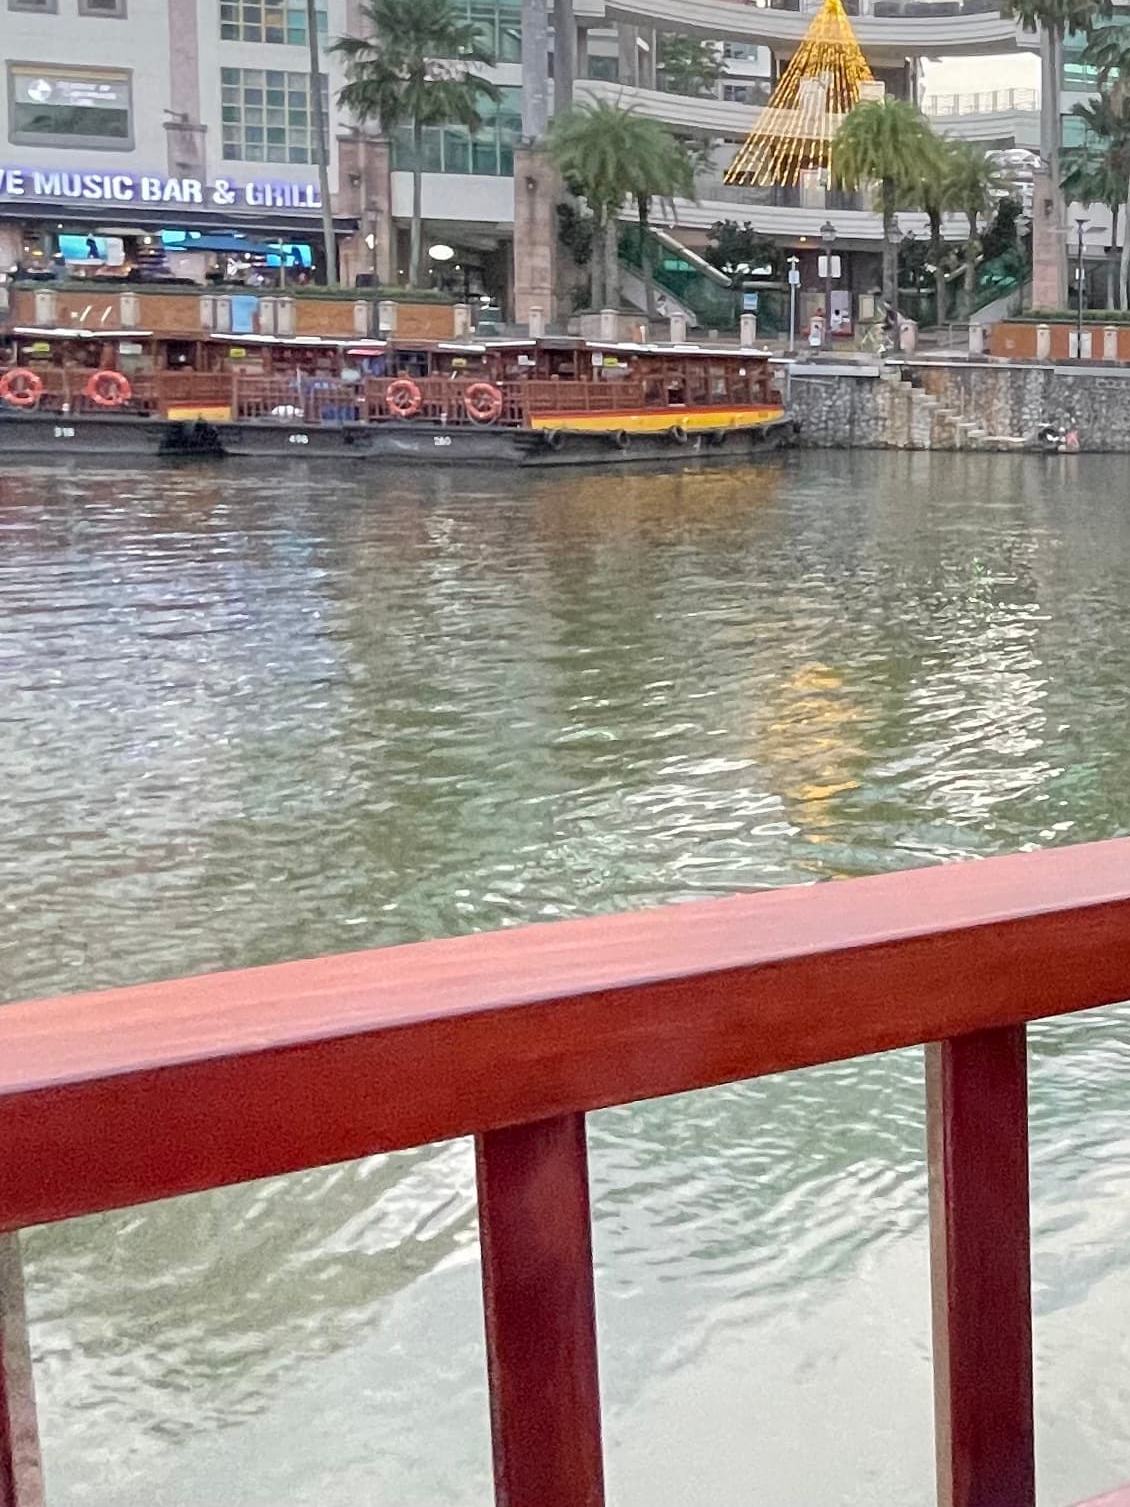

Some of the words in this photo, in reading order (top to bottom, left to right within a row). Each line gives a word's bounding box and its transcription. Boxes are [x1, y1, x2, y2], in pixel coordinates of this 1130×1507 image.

[32, 171, 134, 201] MUSIC
[141, 176, 203, 203] BAR
[213, 179, 235, 205] &
[245, 182, 322, 208] GRILL
